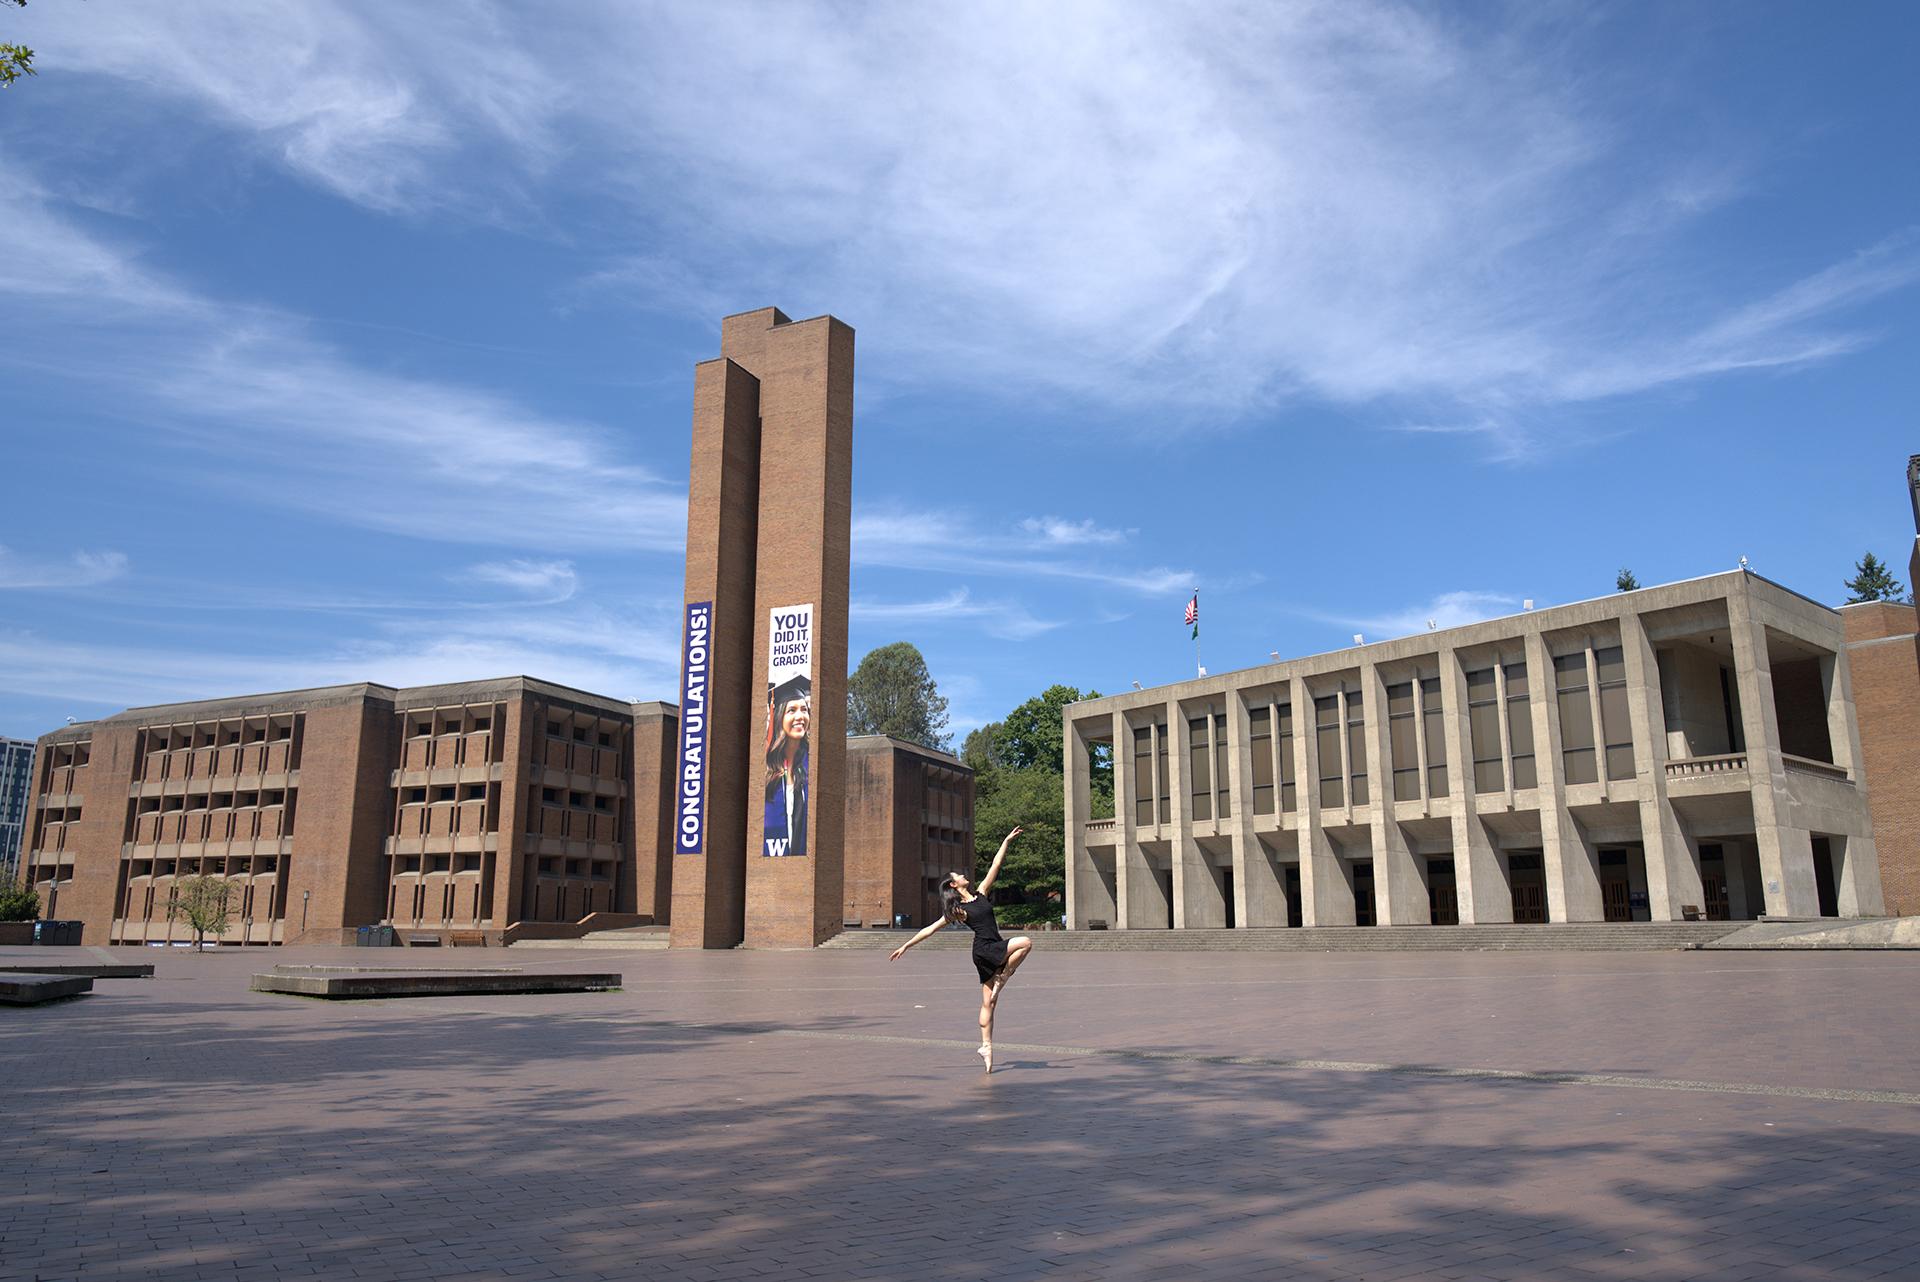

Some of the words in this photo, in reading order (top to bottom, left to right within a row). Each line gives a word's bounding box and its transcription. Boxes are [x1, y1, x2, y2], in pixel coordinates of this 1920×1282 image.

[774, 613, 808, 630] YOU
[774, 631, 795, 643] DID
[797, 629, 809, 641] IT,
[774, 643, 809, 655] HUSKY
[773, 654, 808, 667] GRADS!
[682, 608, 708, 848] CONGRATULATIONS!
[766, 839, 788, 857] W
